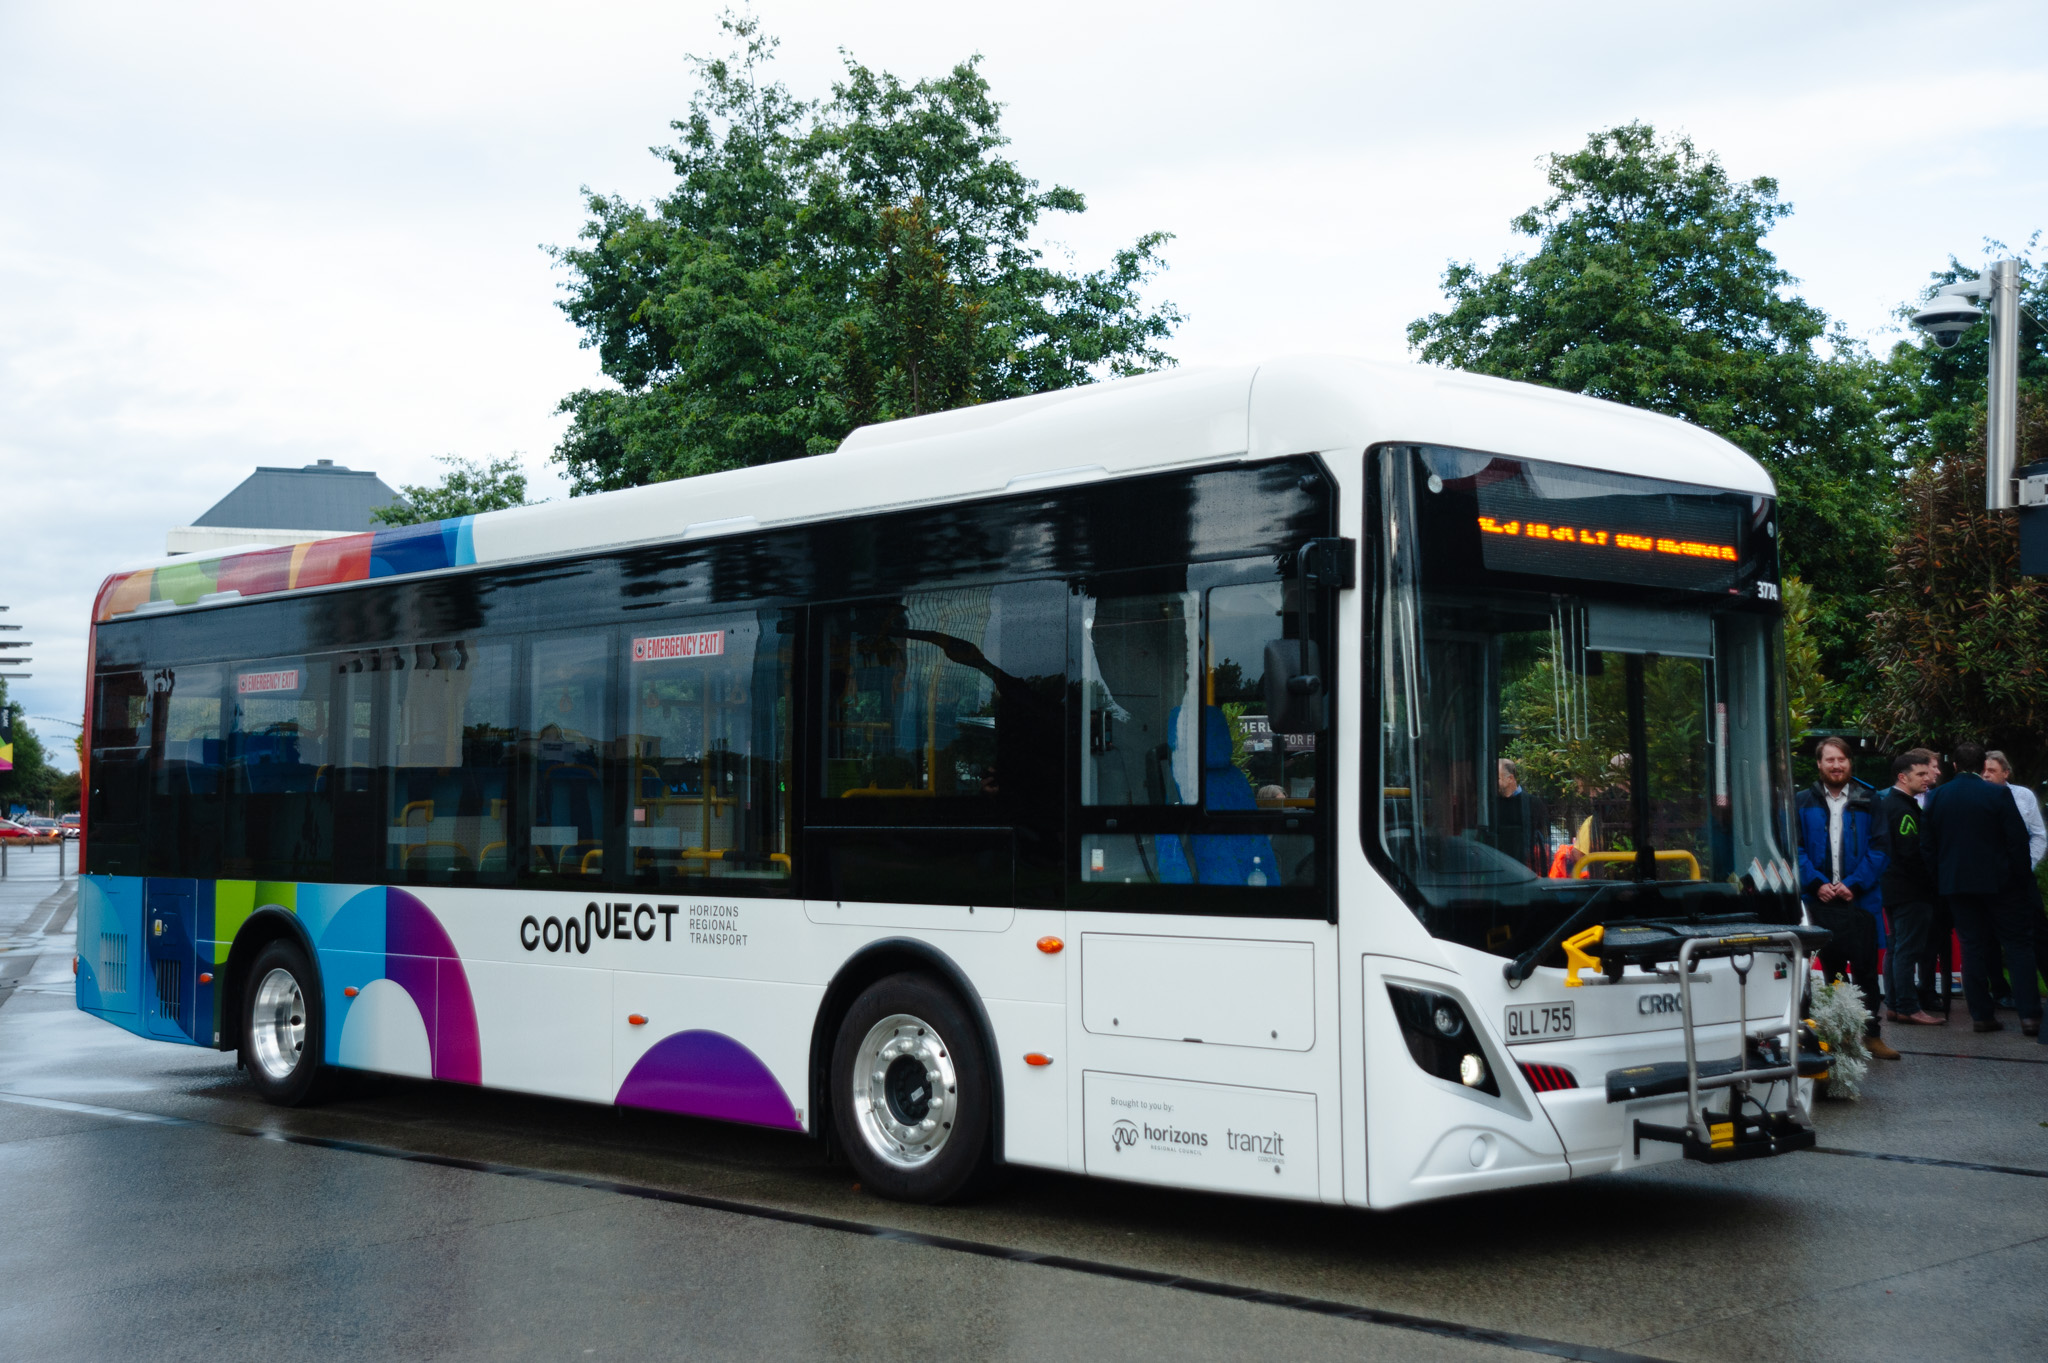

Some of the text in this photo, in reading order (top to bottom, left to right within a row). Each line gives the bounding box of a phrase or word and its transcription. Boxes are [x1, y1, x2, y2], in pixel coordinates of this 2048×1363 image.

[1757, 581, 1778, 601] 3774
[647, 633, 718, 659] EMERGENCY EXIT
[248, 672, 295, 691] EMERGENCY EXIT
[689, 904, 739, 918] HORIZONS
[689, 919, 738, 932] REGIONAL
[689, 932, 748, 946] TRANSPORT
[1508, 1006, 1572, 1036] QLL755
[1110, 1096, 1175, 1113] Brought to you by:
[1144, 1122, 1209, 1147] horizons
[1226, 1128, 1285, 1156] tranzit
[1150, 1144, 1202, 1156] REGIONAL COUNCIL
[1257, 1155, 1286, 1165] coachlines
